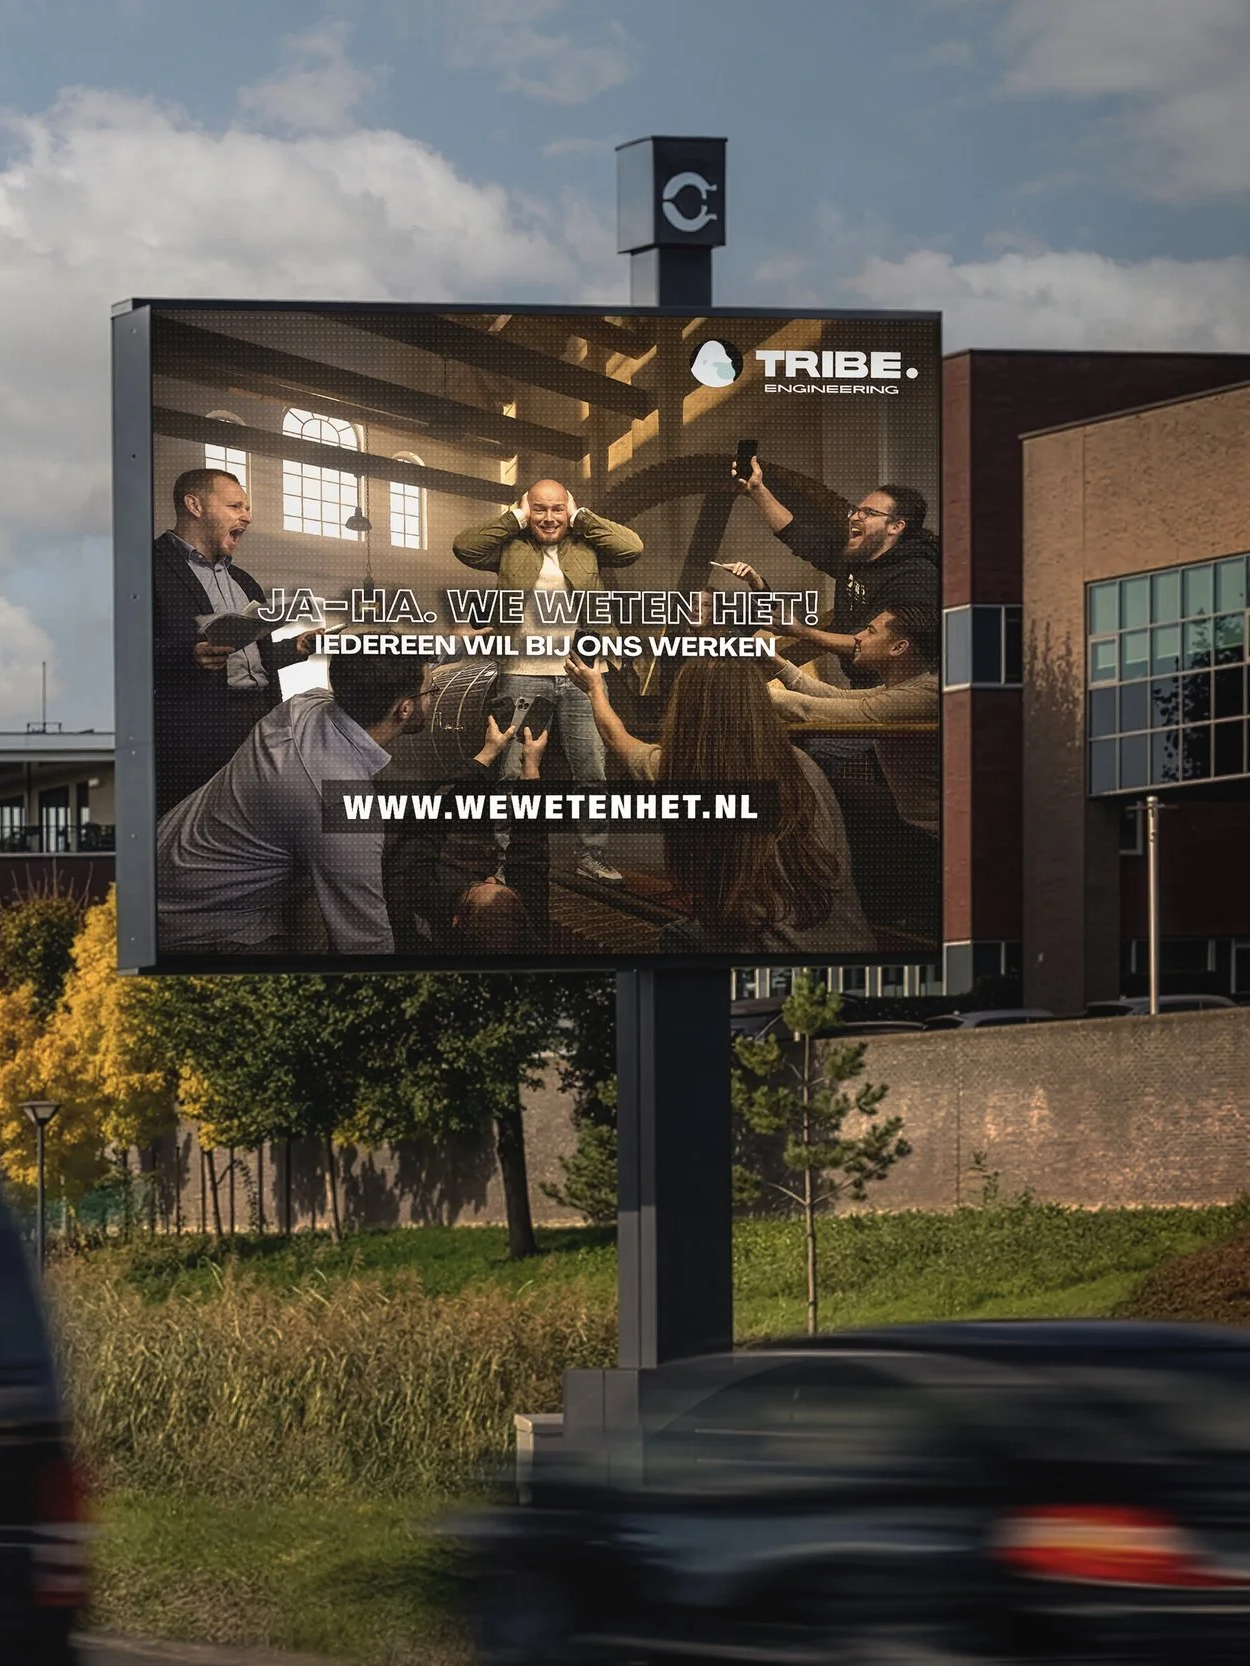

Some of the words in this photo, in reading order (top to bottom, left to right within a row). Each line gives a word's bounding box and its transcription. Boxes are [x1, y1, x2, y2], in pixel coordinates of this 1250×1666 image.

[755, 349, 919, 380] TRIBE.
[764, 383, 900, 395] ENGINEERING
[257, 588, 438, 623] JA-HA.
[447, 589, 525, 624] WE
[533, 590, 702, 625] WETEN
[712, 590, 819, 626] HET!
[315, 634, 456, 656] IEDEREEN
[461, 635, 520, 656] WIL
[526, 635, 571, 656] BIJ
[576, 635, 643, 657] ONS
[648, 636, 776, 658] WERKEN
[342, 794, 759, 820] WWW.WEWETENHET.NL
